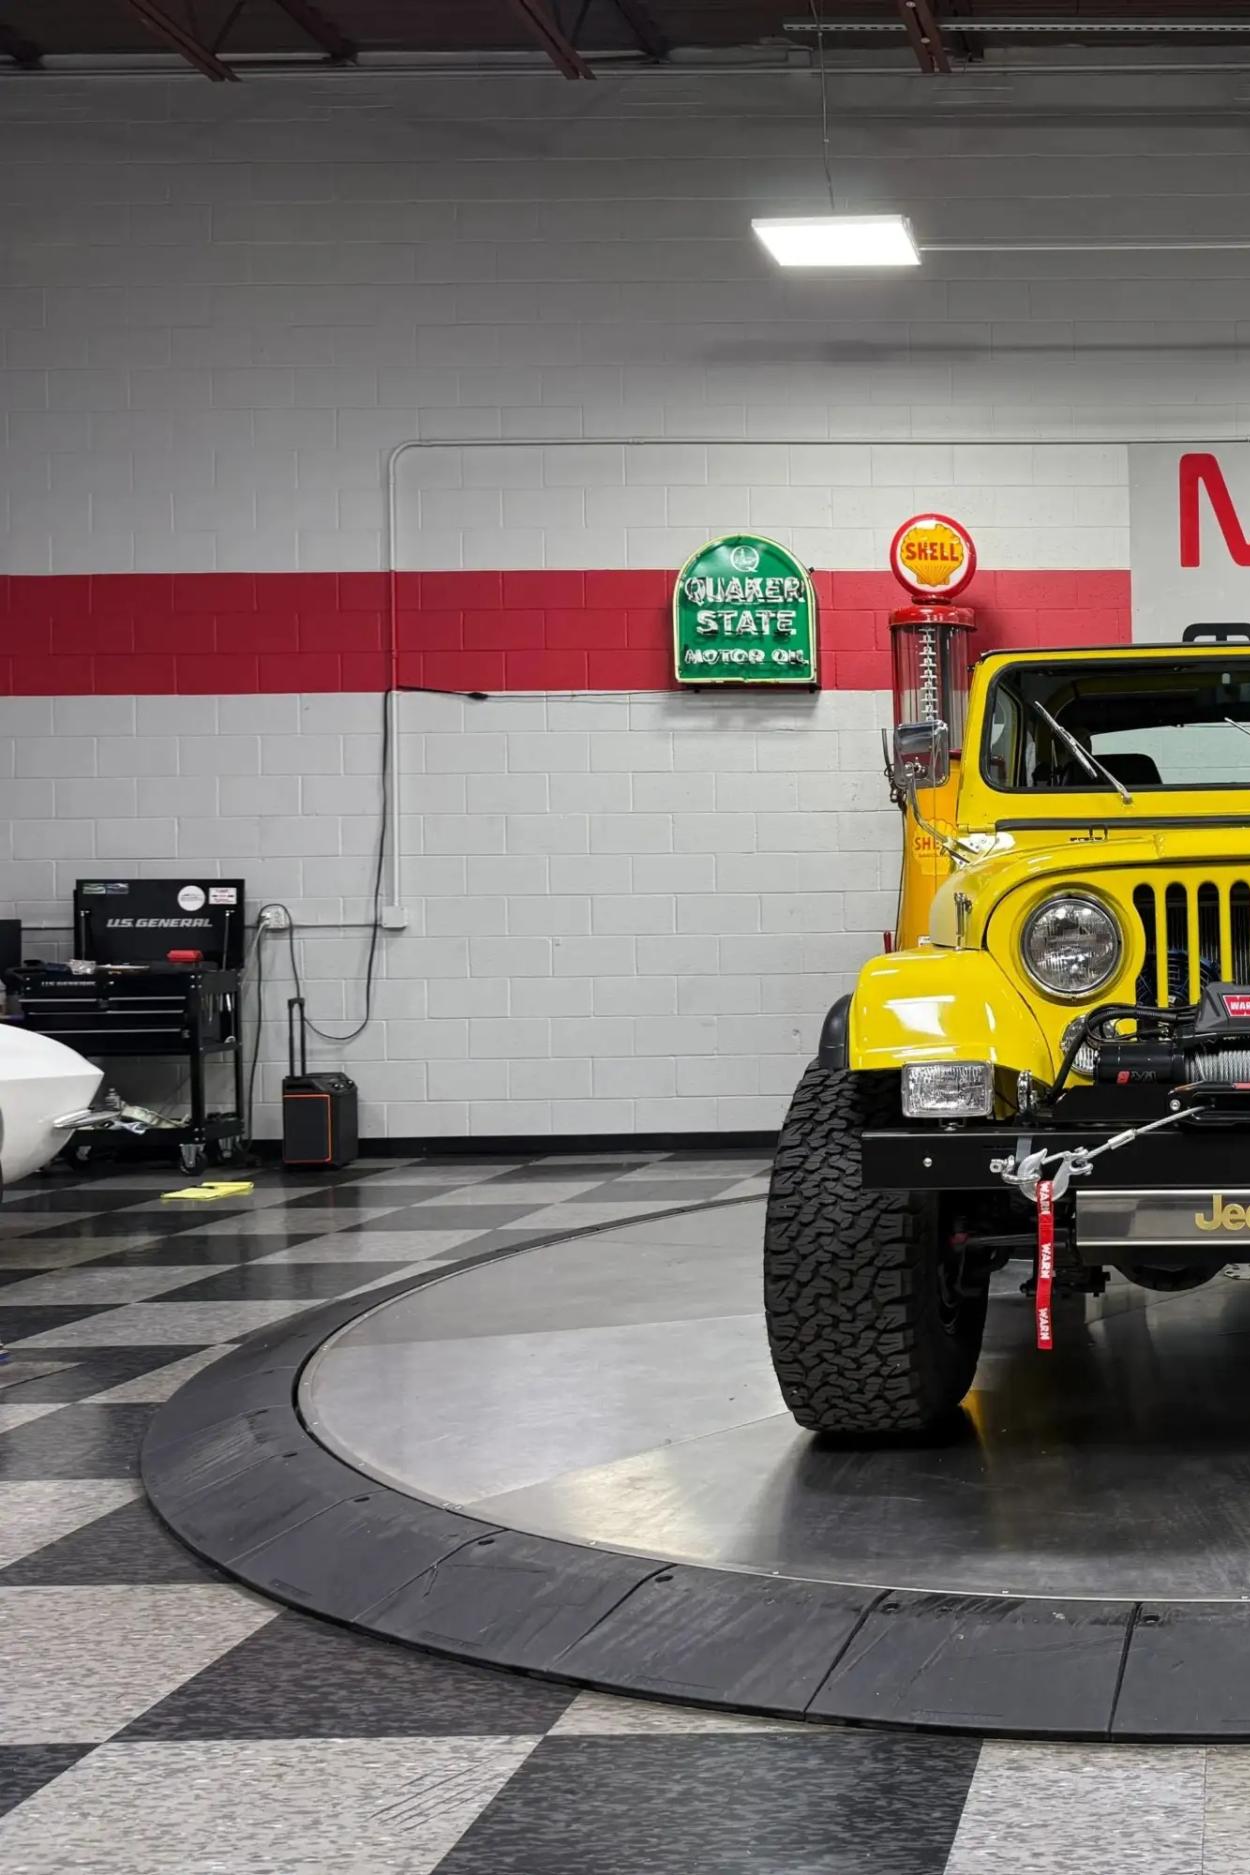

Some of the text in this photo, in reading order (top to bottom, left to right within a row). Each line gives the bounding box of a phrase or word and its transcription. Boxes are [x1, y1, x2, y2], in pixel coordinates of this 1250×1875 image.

[905, 541, 960, 562] SHELL
[684, 576, 805, 606] QUAKER
[696, 610, 797, 636] STATE
[684, 648, 809, 664] MOTOR OIL
[135, 918, 213, 928] GENERAL
[1040, 1243, 1051, 1278] WARN
[1038, 1307, 1050, 1340] WARN
